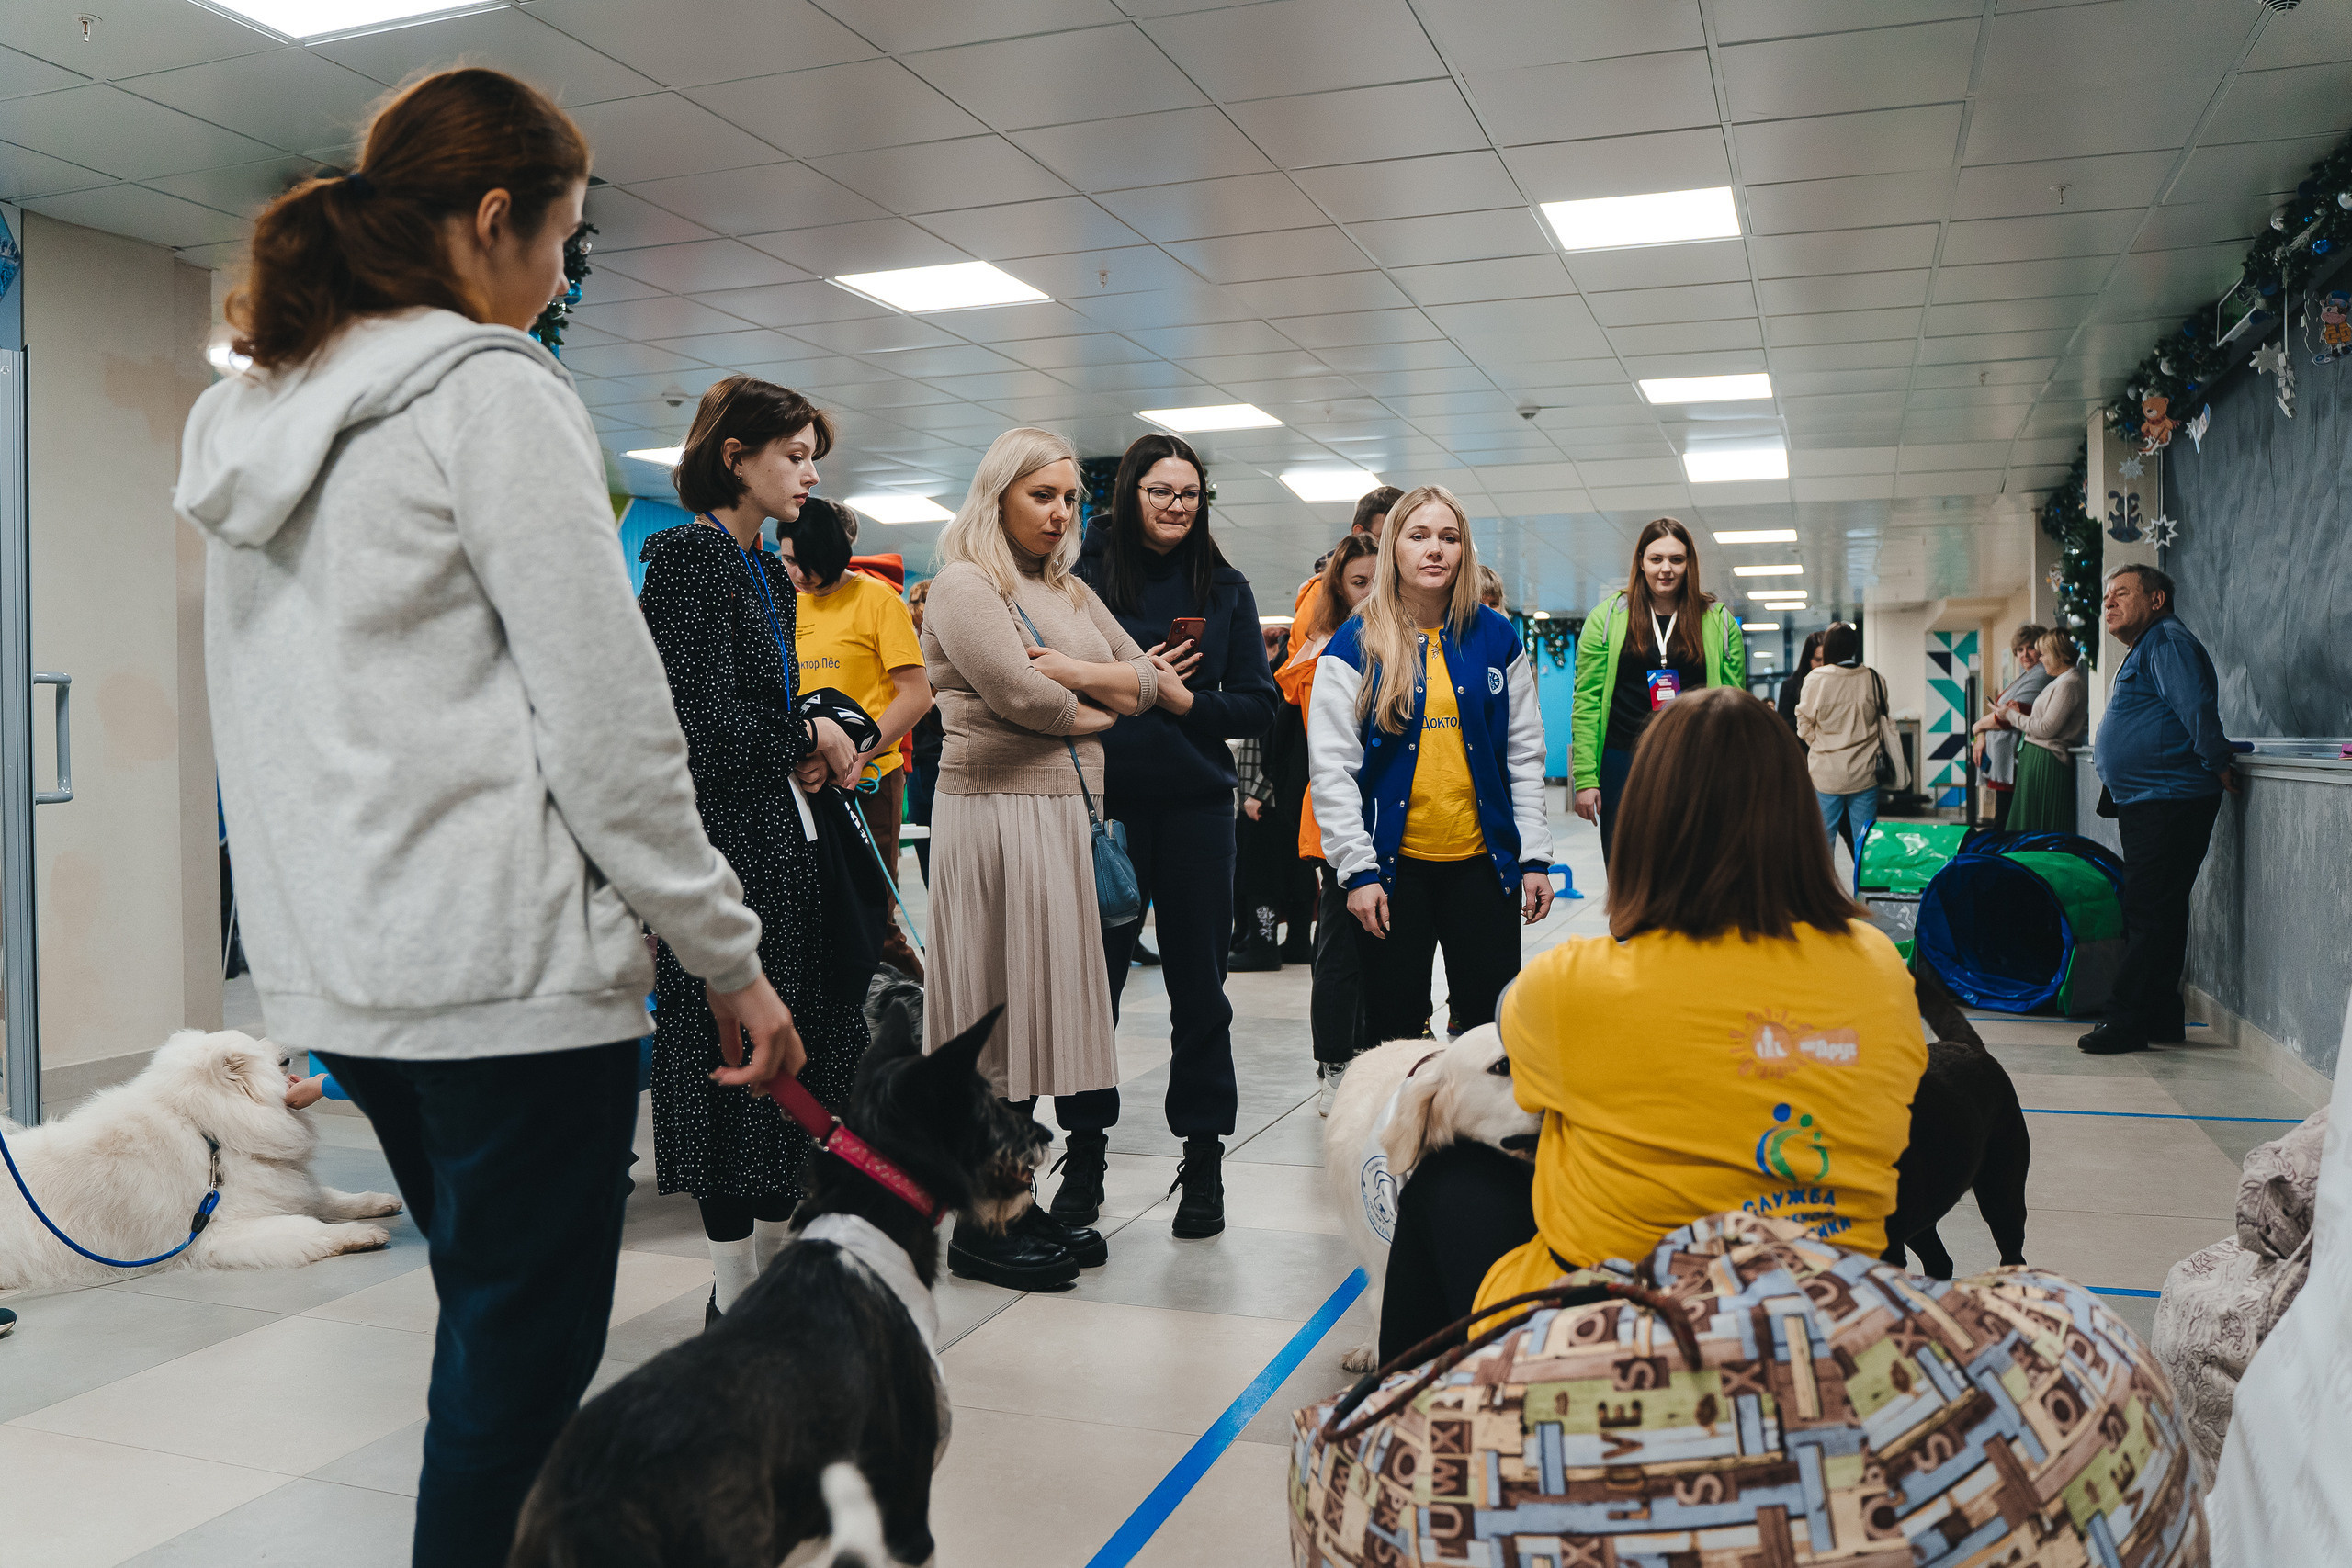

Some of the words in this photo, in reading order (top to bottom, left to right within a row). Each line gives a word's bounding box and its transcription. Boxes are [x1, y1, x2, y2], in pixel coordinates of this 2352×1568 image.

[798, 660, 820, 671] ктор
[821, 657, 841, 669] Пёс
[1742, 1187, 1836, 1216] СЛУЖБА
[1597, 1399, 1651, 1521] LOVE
